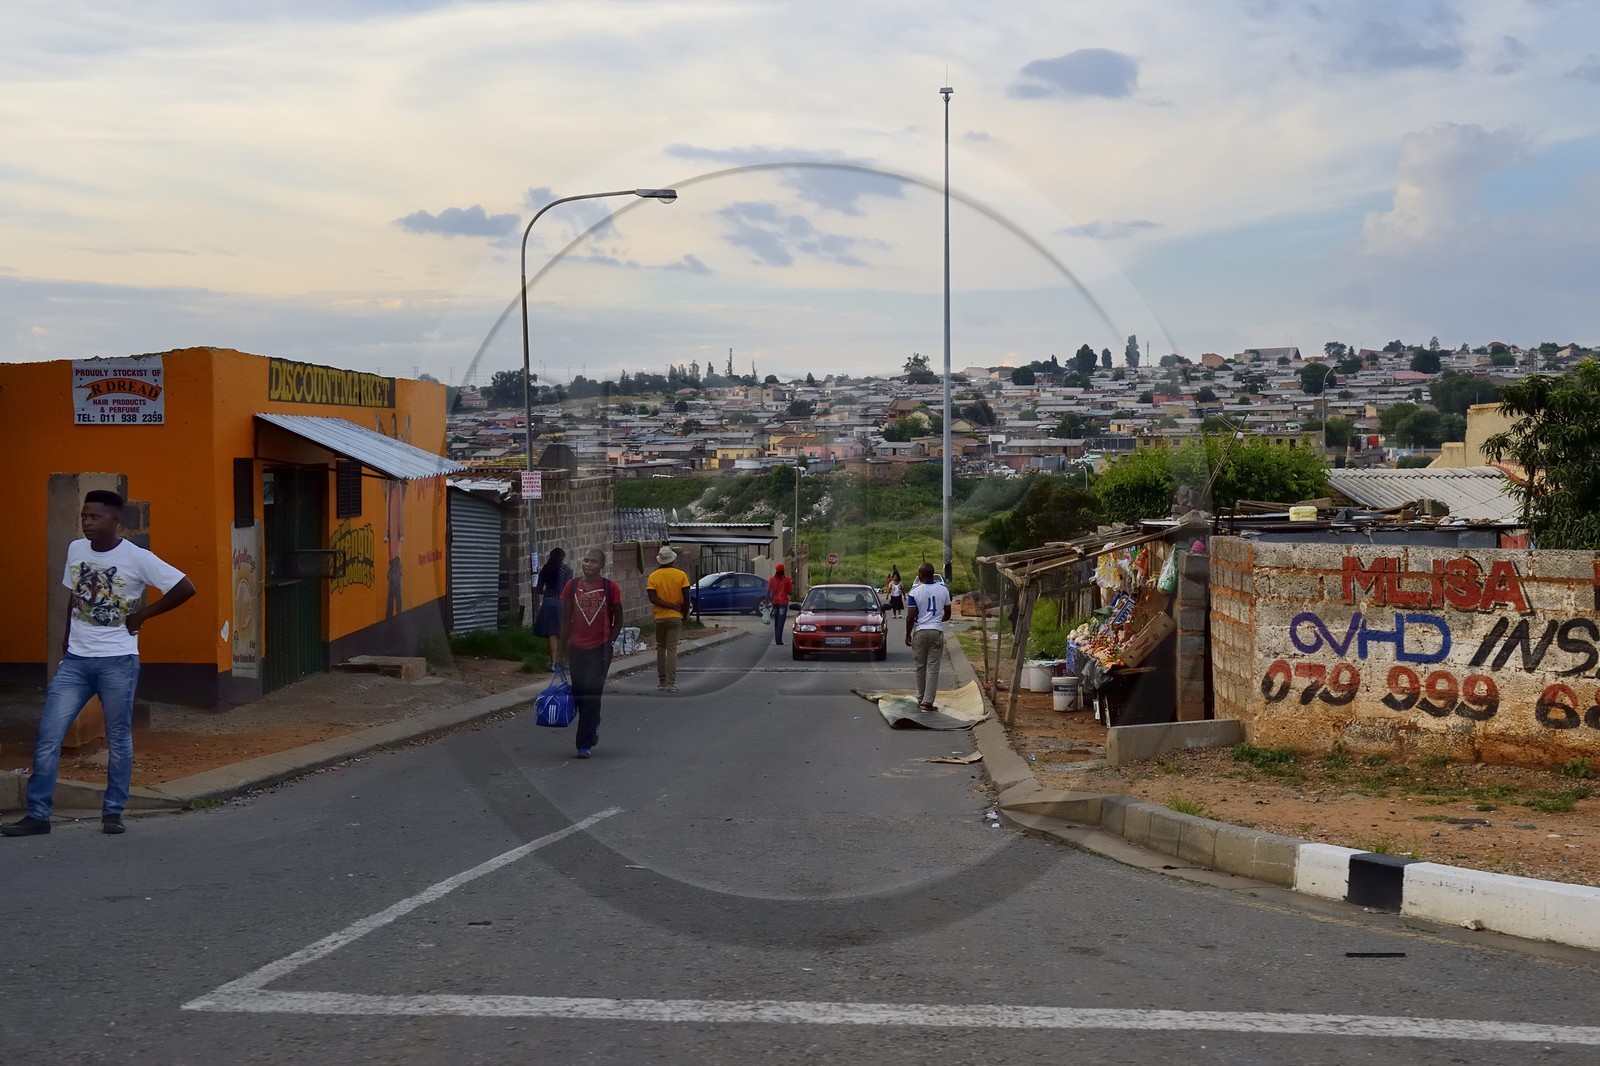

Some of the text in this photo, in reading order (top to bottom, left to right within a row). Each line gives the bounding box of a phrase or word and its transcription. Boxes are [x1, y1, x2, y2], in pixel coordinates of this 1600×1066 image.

[75, 369, 161, 377] PROUDLY STOCKIST OF
[106, 380, 159, 400] DREAD
[76, 414, 163, 423] TEL: 011 938 2359
[927, 595, 937, 616] 4
[1468, 617, 1600, 680] INS
[1261, 659, 1361, 706] 079
[1381, 665, 1500, 721] 999
